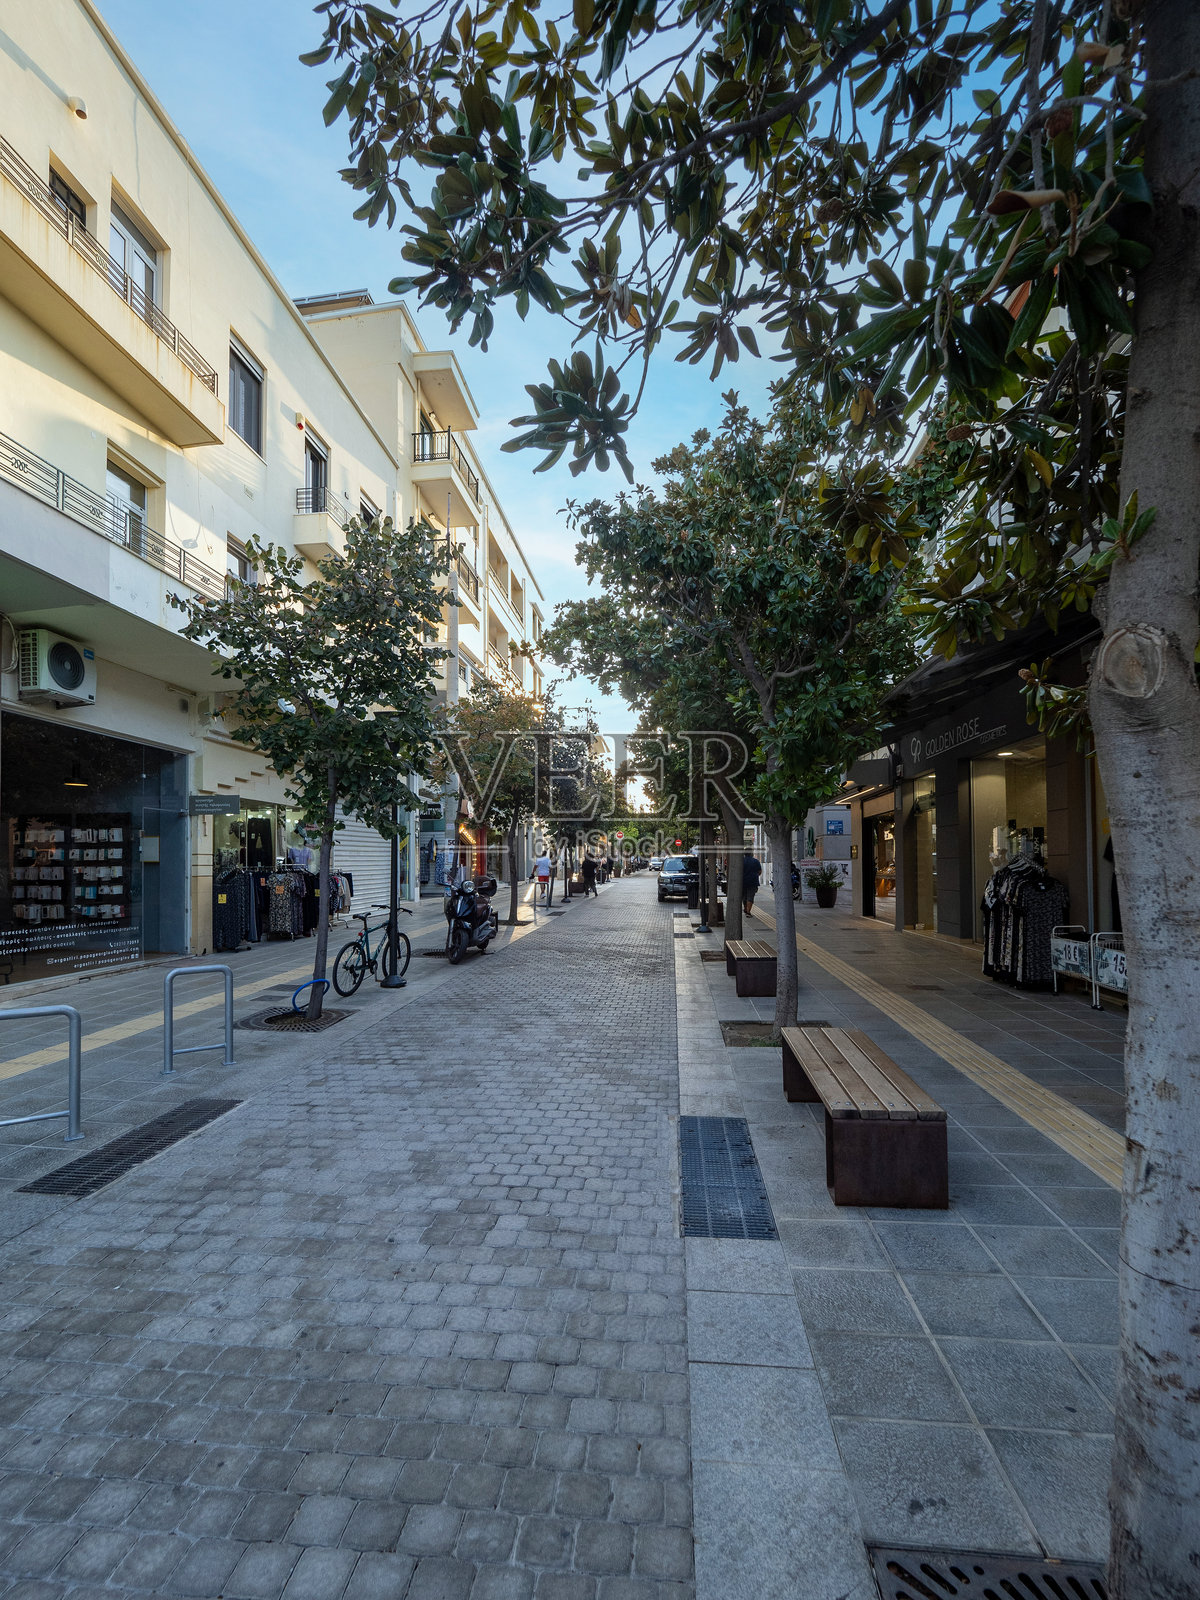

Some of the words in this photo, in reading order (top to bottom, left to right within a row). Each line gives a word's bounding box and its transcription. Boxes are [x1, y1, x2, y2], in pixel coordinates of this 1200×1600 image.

[925, 728, 955, 757] GOLDEN
[956, 717, 980, 742] ROSE
[1, 928, 28, 936] πισκευές
[1063, 943, 1072, 961] 18
